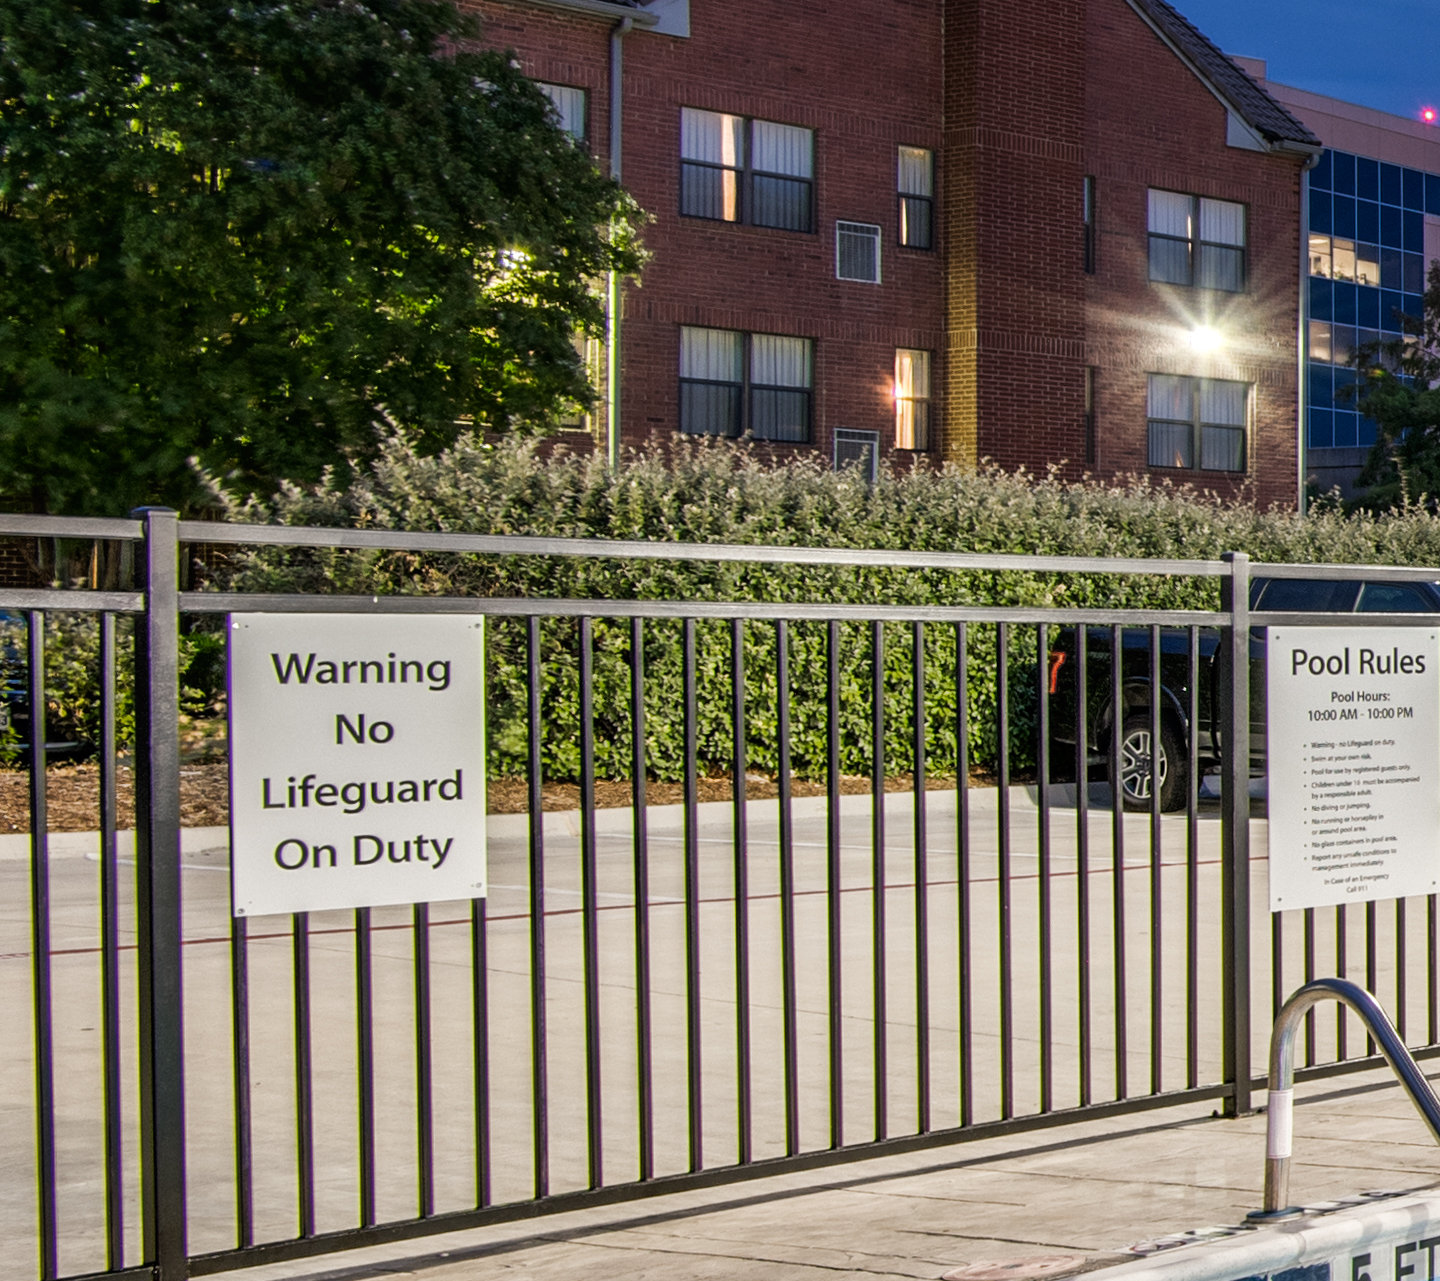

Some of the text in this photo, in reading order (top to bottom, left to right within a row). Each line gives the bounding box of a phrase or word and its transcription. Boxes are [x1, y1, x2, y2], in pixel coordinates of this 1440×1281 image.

[271, 652, 451, 691] Warning
[1292, 646, 1426, 676] Pool Rules
[1331, 691, 1391, 702] Pool Hours:
[335, 713, 395, 745] No
[1308, 709, 1337, 721] 10:00
[1340, 708, 1358, 720] AM
[1368, 708, 1395, 719] 10:00
[1397, 707, 1413, 718] PM
[262, 769, 463, 814] Lifeguard
[1311, 780, 1335, 788] Children
[1311, 792, 1318, 800] by
[274, 834, 454, 870] On Duty
